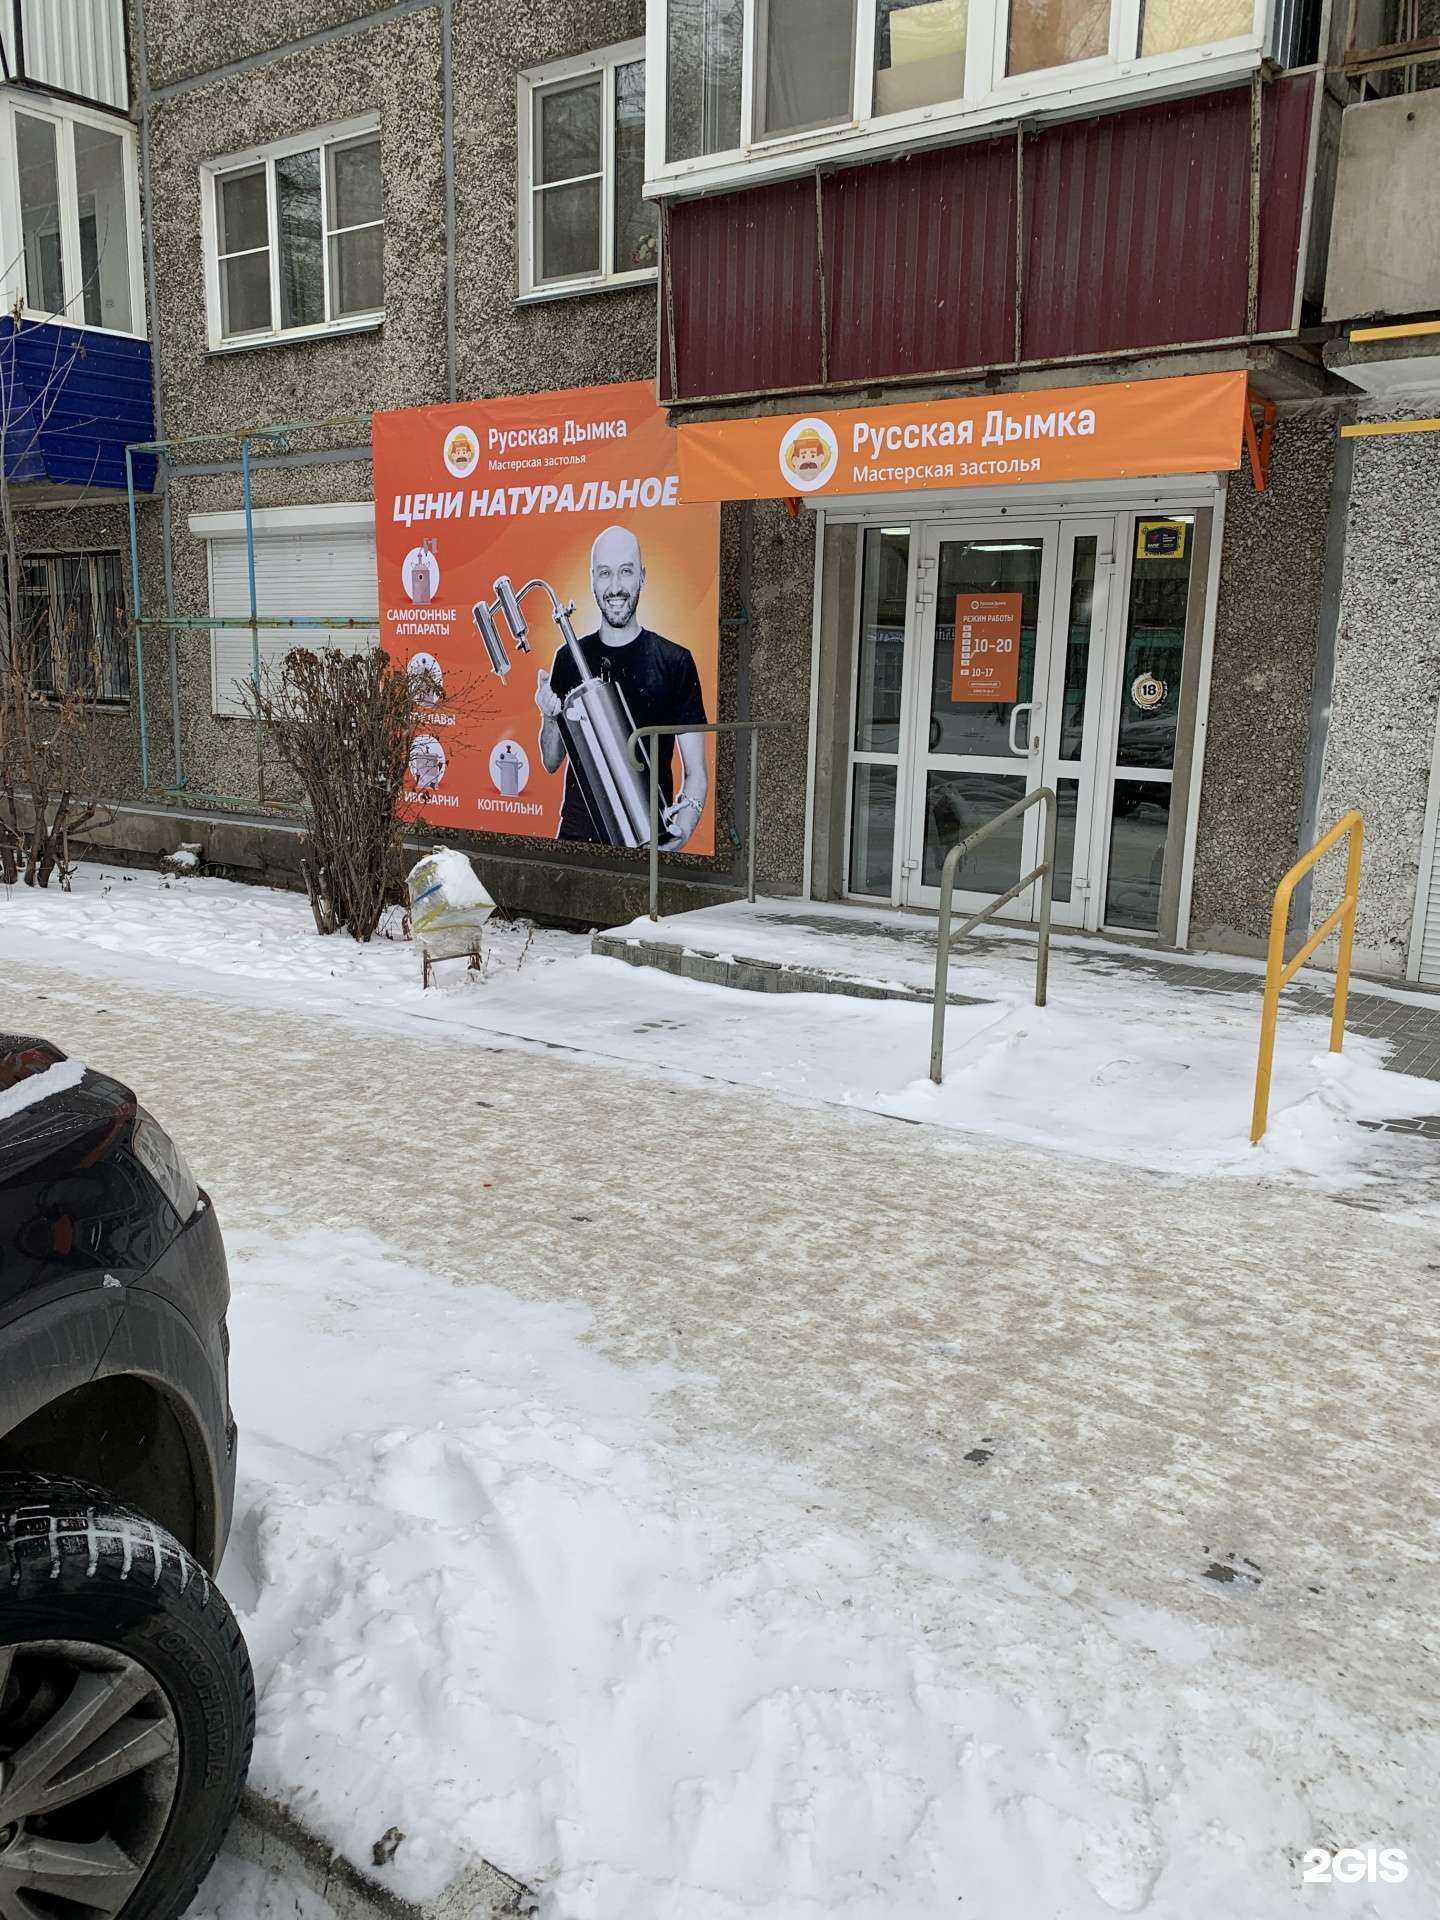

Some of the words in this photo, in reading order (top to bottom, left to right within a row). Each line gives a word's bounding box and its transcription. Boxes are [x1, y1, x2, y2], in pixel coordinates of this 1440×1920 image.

[488, 425, 559, 454] Русская
[562, 419, 628, 446] Дымка
[852, 419, 974, 460] Русская
[981, 408, 1096, 448] Дымка
[488, 457, 542, 472] Мастерская
[544, 454, 586, 468] застолья
[853, 463, 954, 485] Мастерская
[959, 457, 1041, 476] застолья
[392, 490, 464, 528] ЦЕНИ
[468, 475, 680, 518] НАТУРАЛЬНОЕ
[386, 608, 457, 621] САМОГОННЫЕ
[962, 615, 987, 623] РЕЖИМ
[987, 614, 1014, 622] РАБОТЫ
[396, 623, 450, 636] АППАРАТЫ
[1142, 684, 1157, 696] 18
[477, 798, 544, 817] КОПТИЛЬНИ
